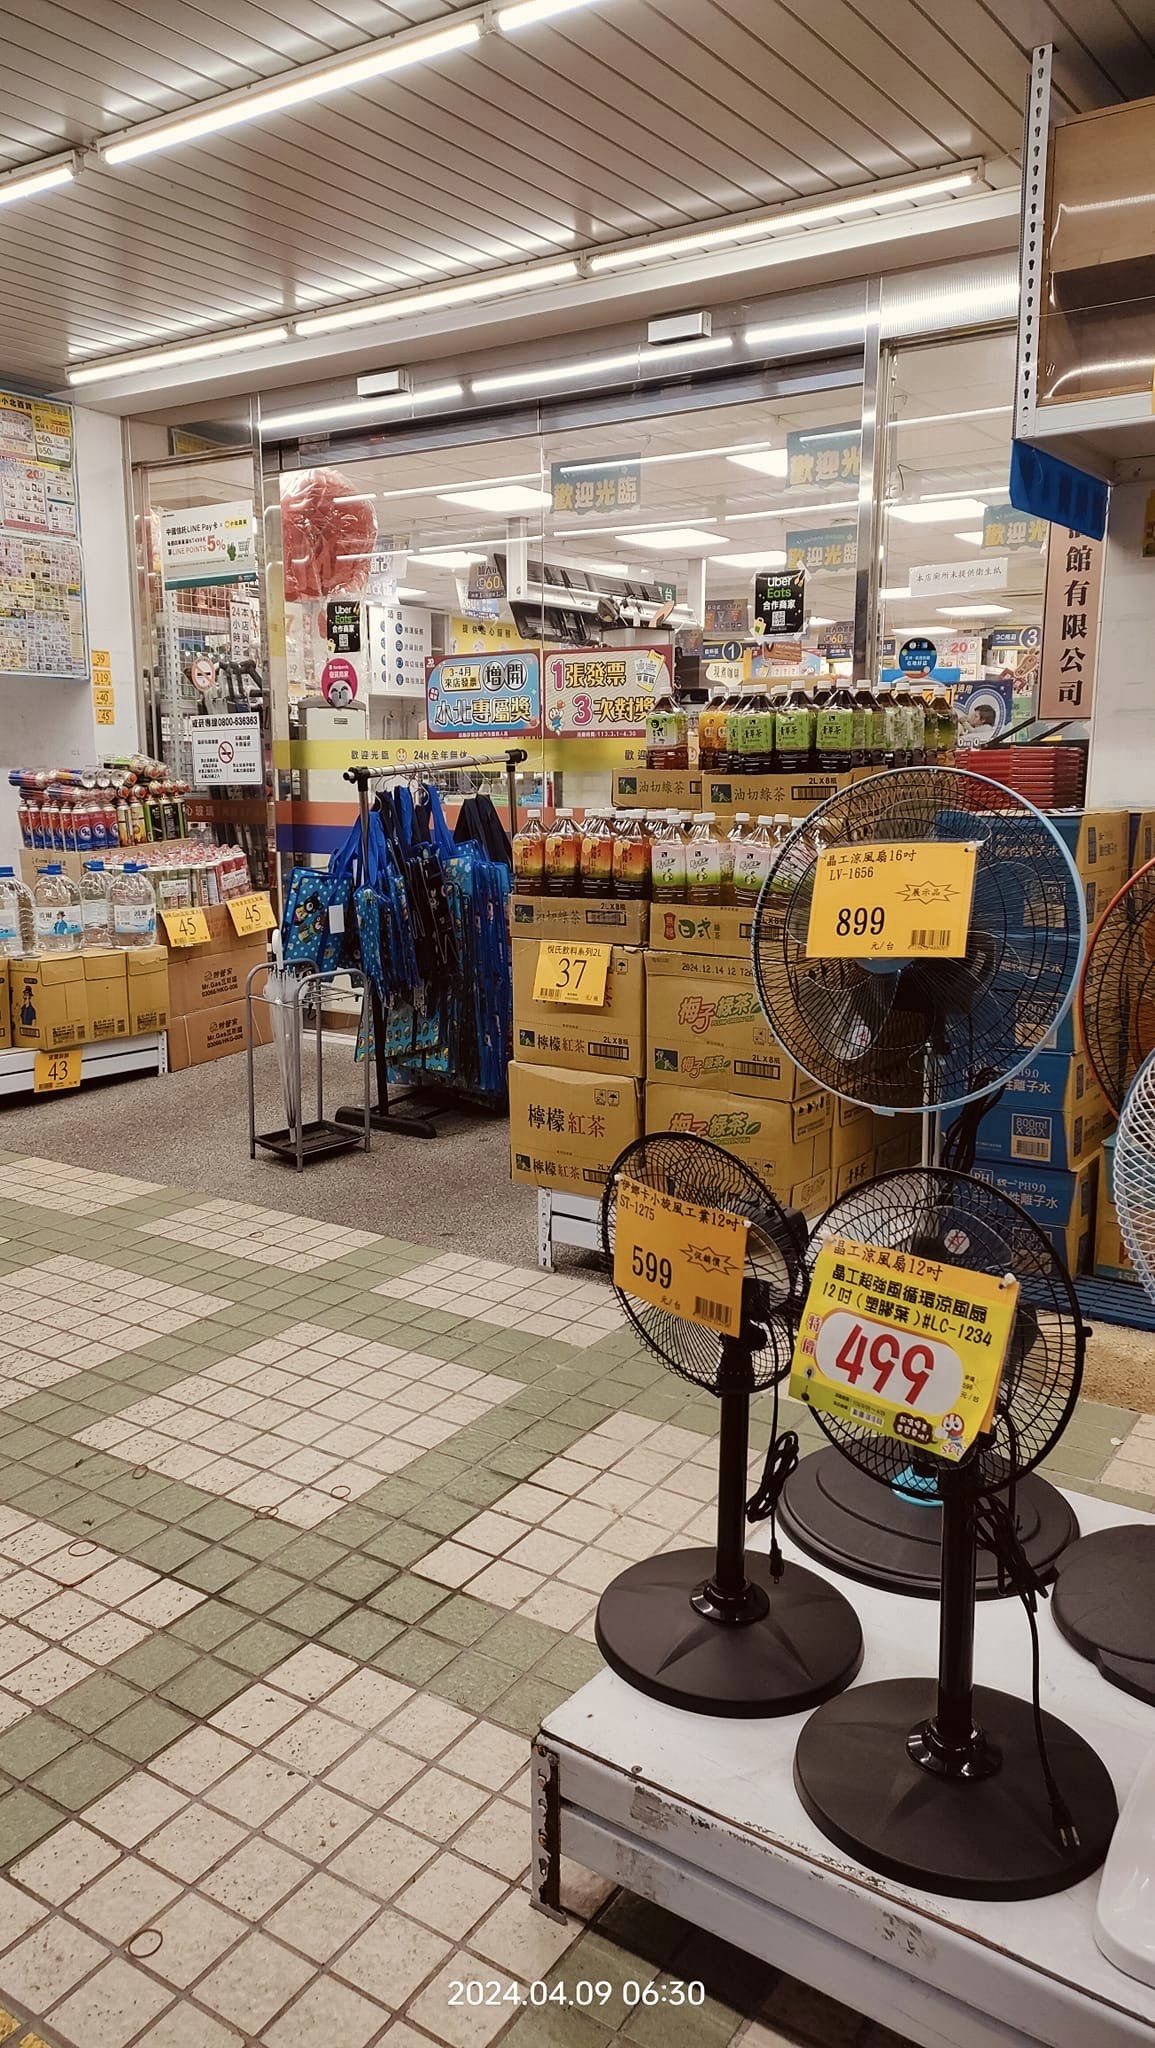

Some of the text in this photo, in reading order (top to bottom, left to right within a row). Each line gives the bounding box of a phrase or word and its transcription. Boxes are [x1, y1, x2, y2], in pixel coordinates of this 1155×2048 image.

[554, 476, 637, 511] 歡迎光臨
[768, 576, 792, 587] Uber
[767, 587, 792, 599] Eats
[335, 605, 352, 614] Uber
[763, 600, 796, 611] 合作商家
[335, 615, 353, 625] Eats
[1058, 526, 1094, 706] 館有限公司
[734, 787, 786, 802] 油切綠茶
[826, 849, 917, 867] 晶工涼風扇16吋
[829, 866, 874, 881] LV-1656
[911, 888, 941, 897] 展示品
[244, 904, 262, 923] 45
[836, 906, 885, 937] 899
[179, 917, 197, 936] 45
[555, 957, 588, 989] 37
[48, 1060, 68, 1081] 43
[527, 1103, 606, 1138] 檸檬紅茶
[620, 1194, 655, 1221] ST-1275
[632, 1244, 673, 1290] 599
[831, 1263, 988, 1325] 晶工超強風循環涼風扇
[835, 1323, 935, 1406] 499
